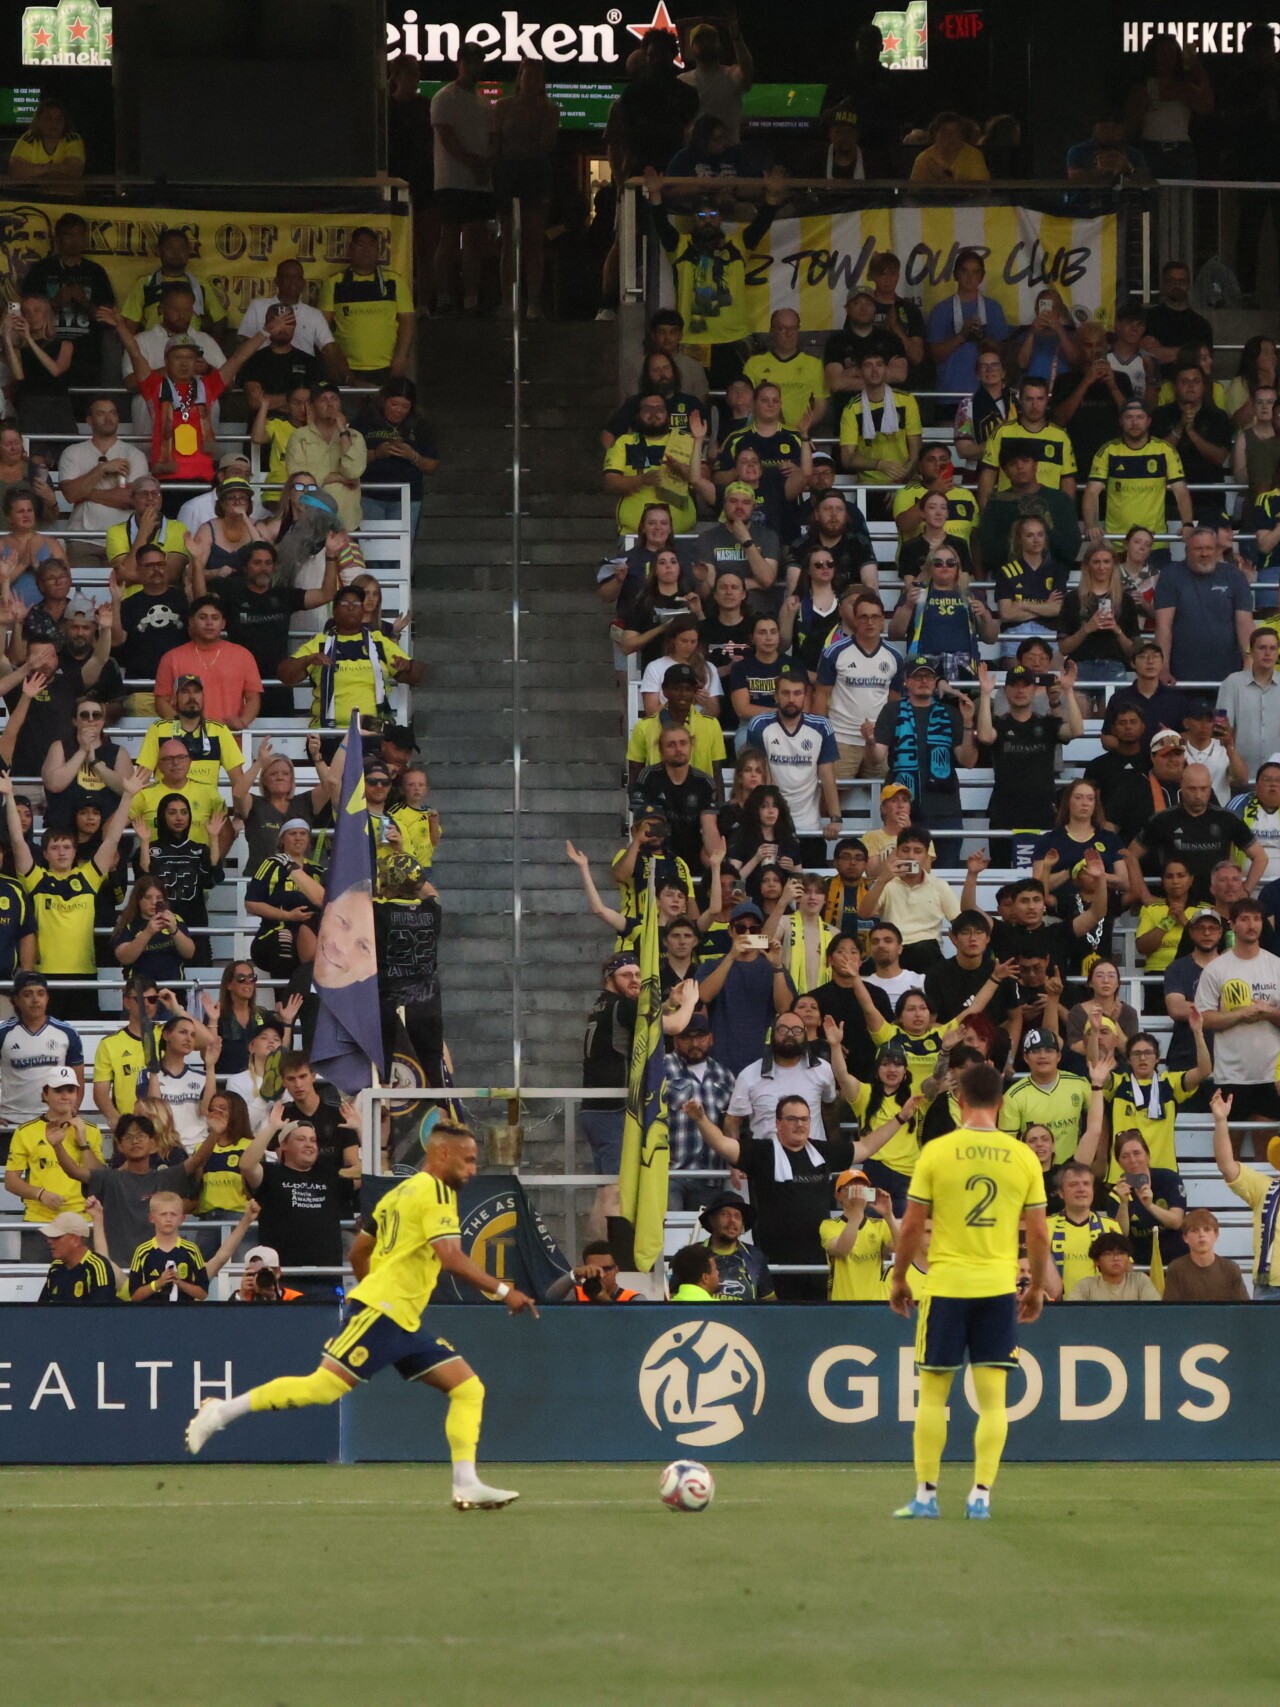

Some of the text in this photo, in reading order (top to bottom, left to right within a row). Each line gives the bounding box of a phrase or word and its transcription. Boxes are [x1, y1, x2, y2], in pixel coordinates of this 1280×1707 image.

[945, 14, 978, 39] EXIT
[83, 219, 392, 266] KING OF THE
[1004, 240, 1094, 286] CLUB
[716, 550, 747, 562] NASHVILL
[938, 605, 955, 615] SC
[247, 613, 284, 624] RENASANT
[1181, 841, 1222, 850] RENASANT
[51, 901, 88, 911] RENASANT
[1252, 982, 1277, 992] Music
[1252, 992, 1270, 1002] City
[955, 1147, 1012, 1163] LOVITZ
[964, 1173, 998, 1227] 2
[463, 1208, 491, 1239] THE
